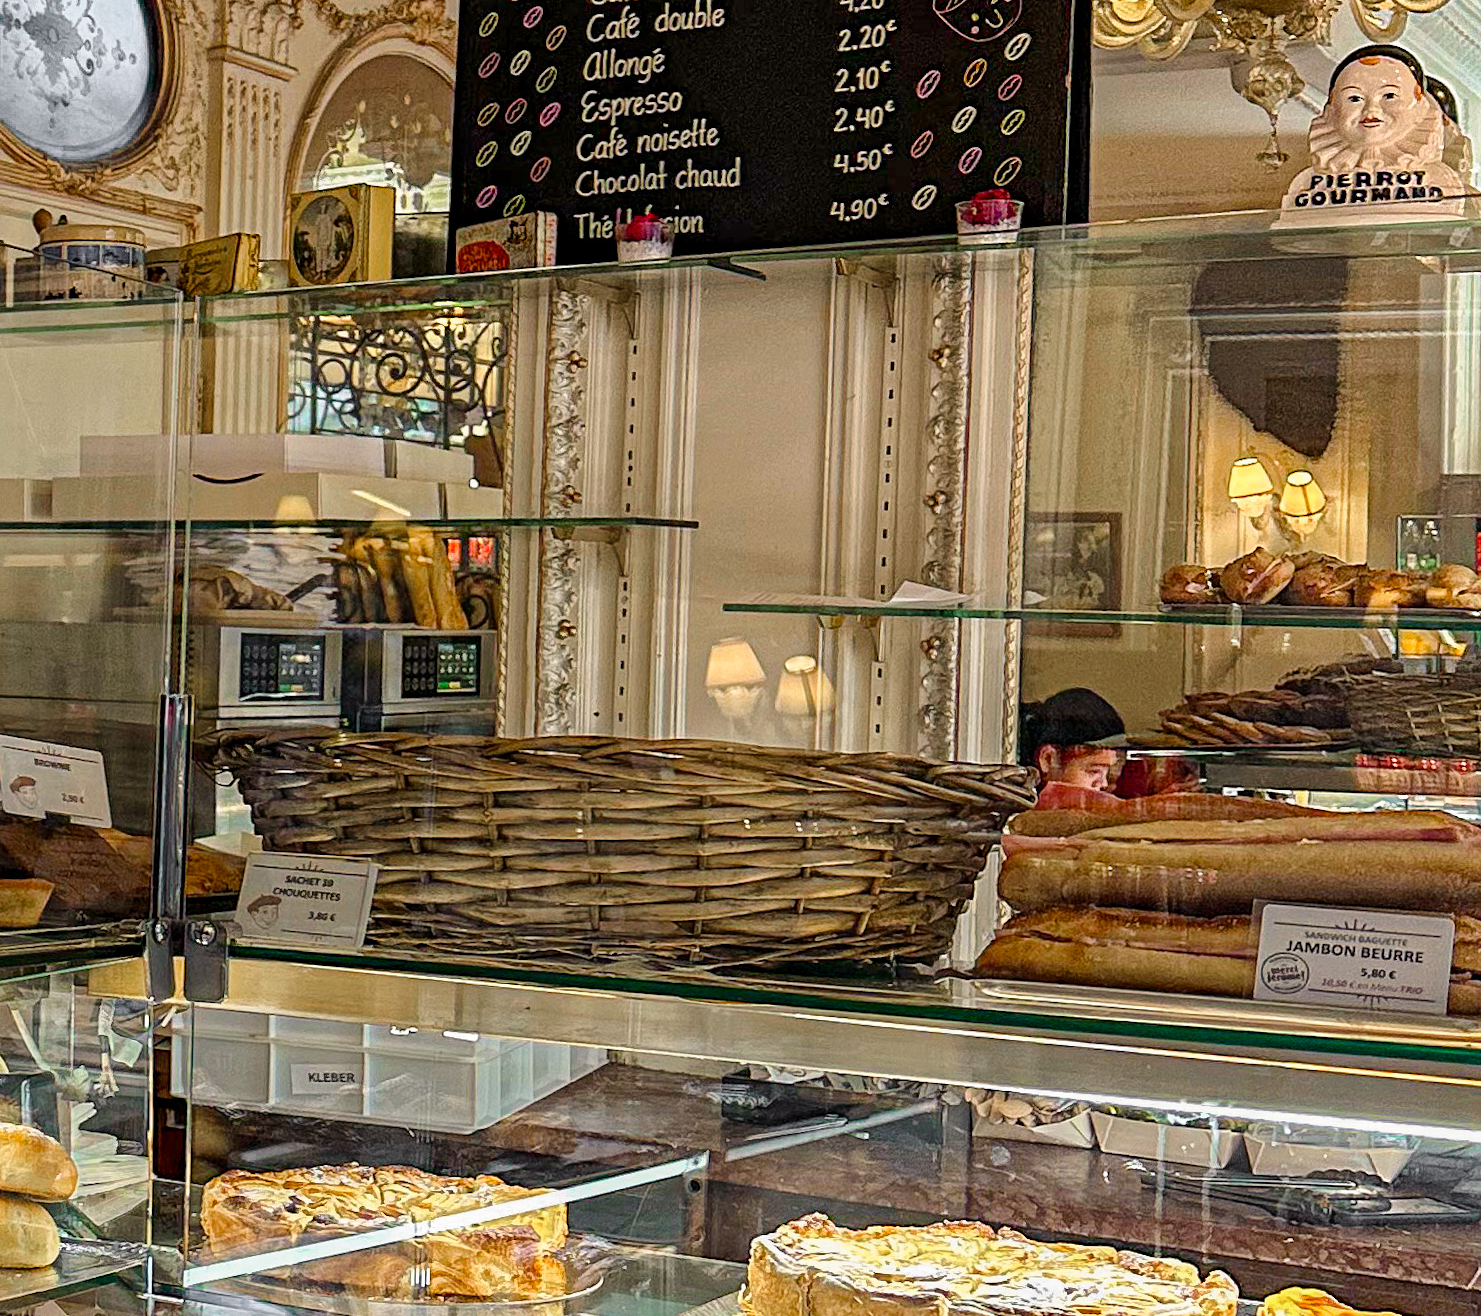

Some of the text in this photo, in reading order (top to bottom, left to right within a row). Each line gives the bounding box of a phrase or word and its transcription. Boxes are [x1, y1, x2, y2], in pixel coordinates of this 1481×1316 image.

[586, 5, 640, 42] Café
[654, 0, 725, 33] double
[580, 89, 683, 126] Espresso
[576, 126, 628, 161] Café
[637, 118, 720, 153] noisette
[575, 160, 667, 197] Chocolat
[674, 156, 741, 189] chaud
[1310, 171, 1426, 190] PIERROT
[1294, 187, 1444, 207] GOURMAND
[574, 212, 613, 239] Thé
[285, 875, 320, 886] SACHET
[272, 887, 341, 902] CHOUQUETTES
[1304, 931, 1408, 947] SANDWICH BAGUETTE
[1286, 940, 1424, 963] JAMBON BEURRE
[1361, 967, 1397, 980] 5,80 €
[1399, 985, 1423, 994] TRIO
[308, 1072, 356, 1083] KLEBER
